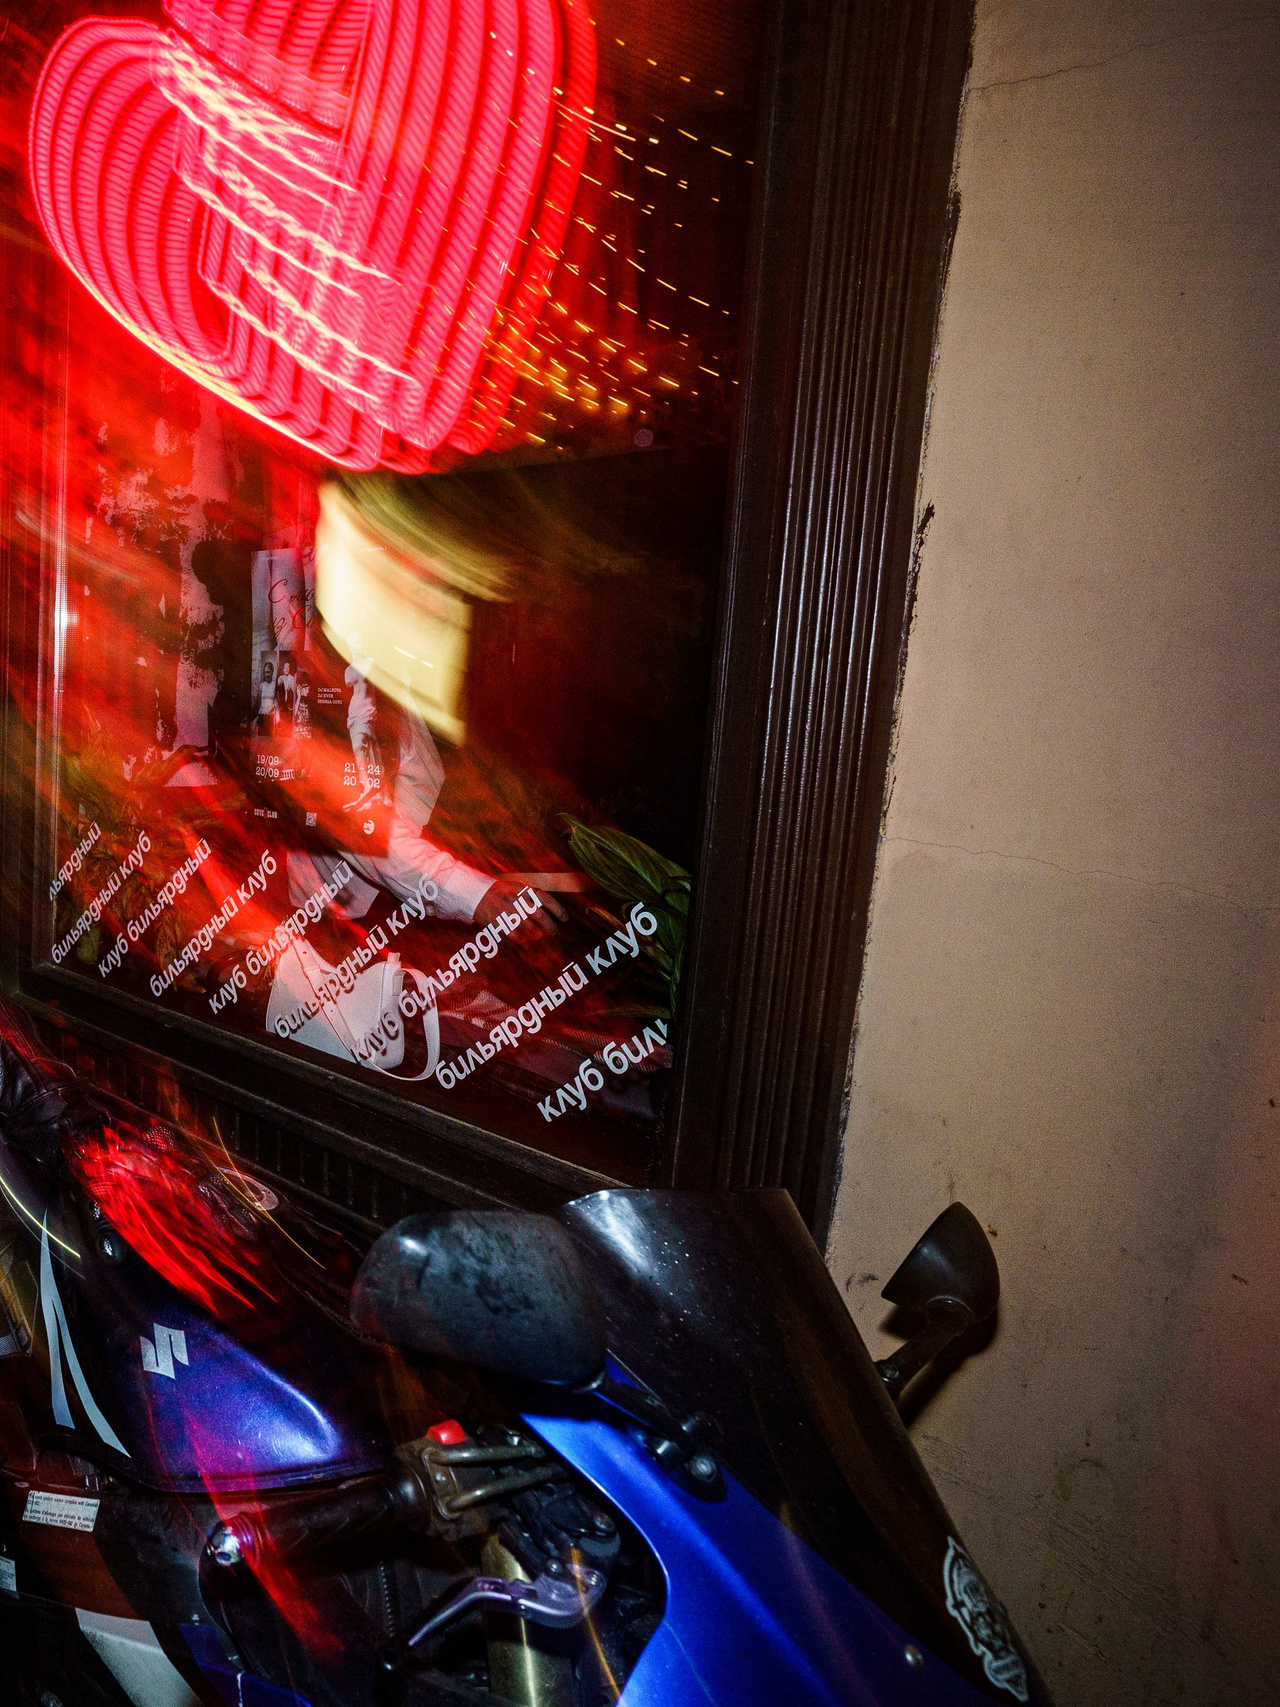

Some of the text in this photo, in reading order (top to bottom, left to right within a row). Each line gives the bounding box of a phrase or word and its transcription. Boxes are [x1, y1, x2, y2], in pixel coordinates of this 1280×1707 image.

[255, 766, 280, 779] 20/09
[256, 754, 279, 767] 19/09
[343, 775, 357, 787] 20
[366, 777, 381, 789] 02
[344, 762, 357, 773] 21
[367, 764, 381, 776] 24
[51, 830, 152, 964] бильярдный клуб
[98, 838, 212, 978] клуб бильярдный
[149, 849, 277, 997] бильярдный клуб
[208, 859, 354, 1015] клуб бильярдный
[274, 872, 440, 1038] бильярдный клуб
[350, 885, 543, 1063] клуб бильярдный
[435, 901, 658, 1090] бильярдный клуб
[536, 1059, 604, 1123] клуб
